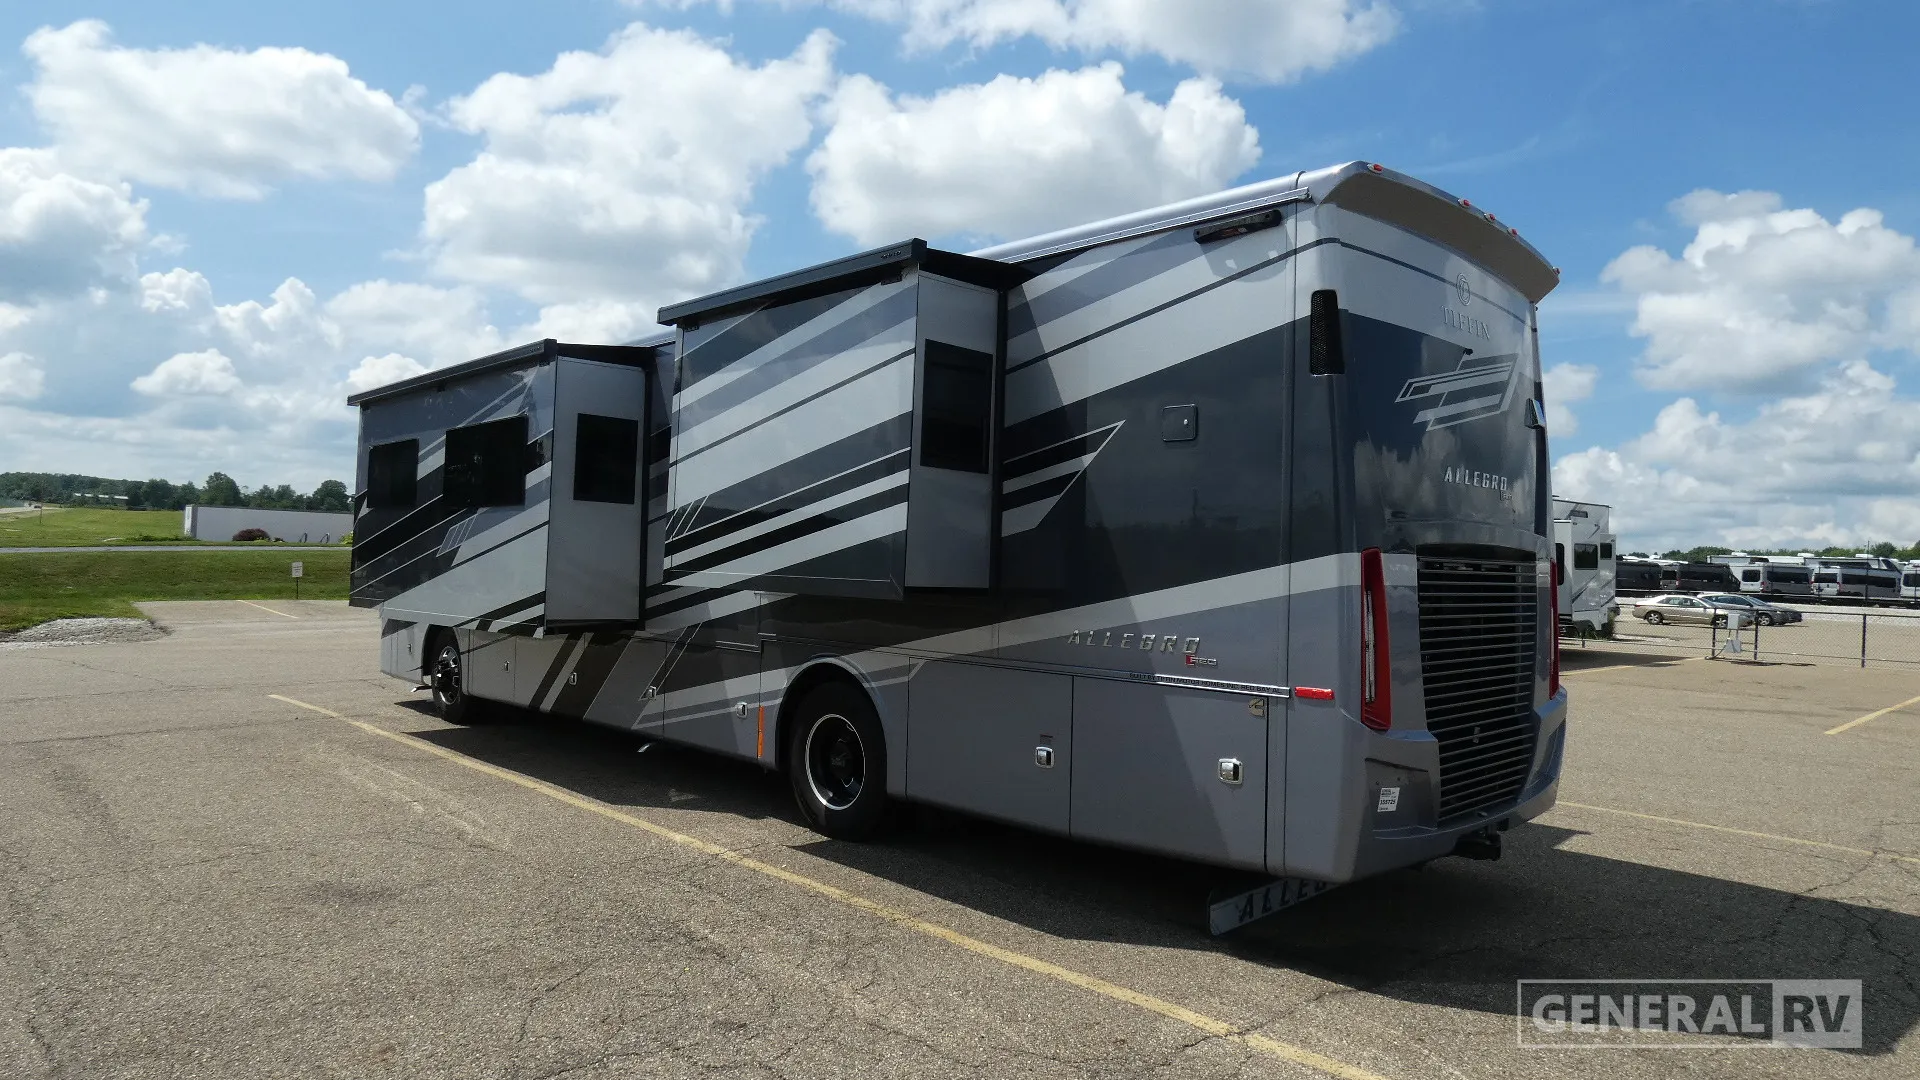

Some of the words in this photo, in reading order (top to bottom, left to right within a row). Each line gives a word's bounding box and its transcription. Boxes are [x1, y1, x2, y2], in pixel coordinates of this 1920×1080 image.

[1440, 305, 1490, 341] TIFFIN
[1444, 466, 1508, 491] ALLEGRO
[1068, 629, 1200, 654] ALLEGRO
[1157, 675, 1176, 683] TIFFIN
[1177, 677, 1200, 685] MOTOR
[1201, 680, 1225, 688] HOMES
